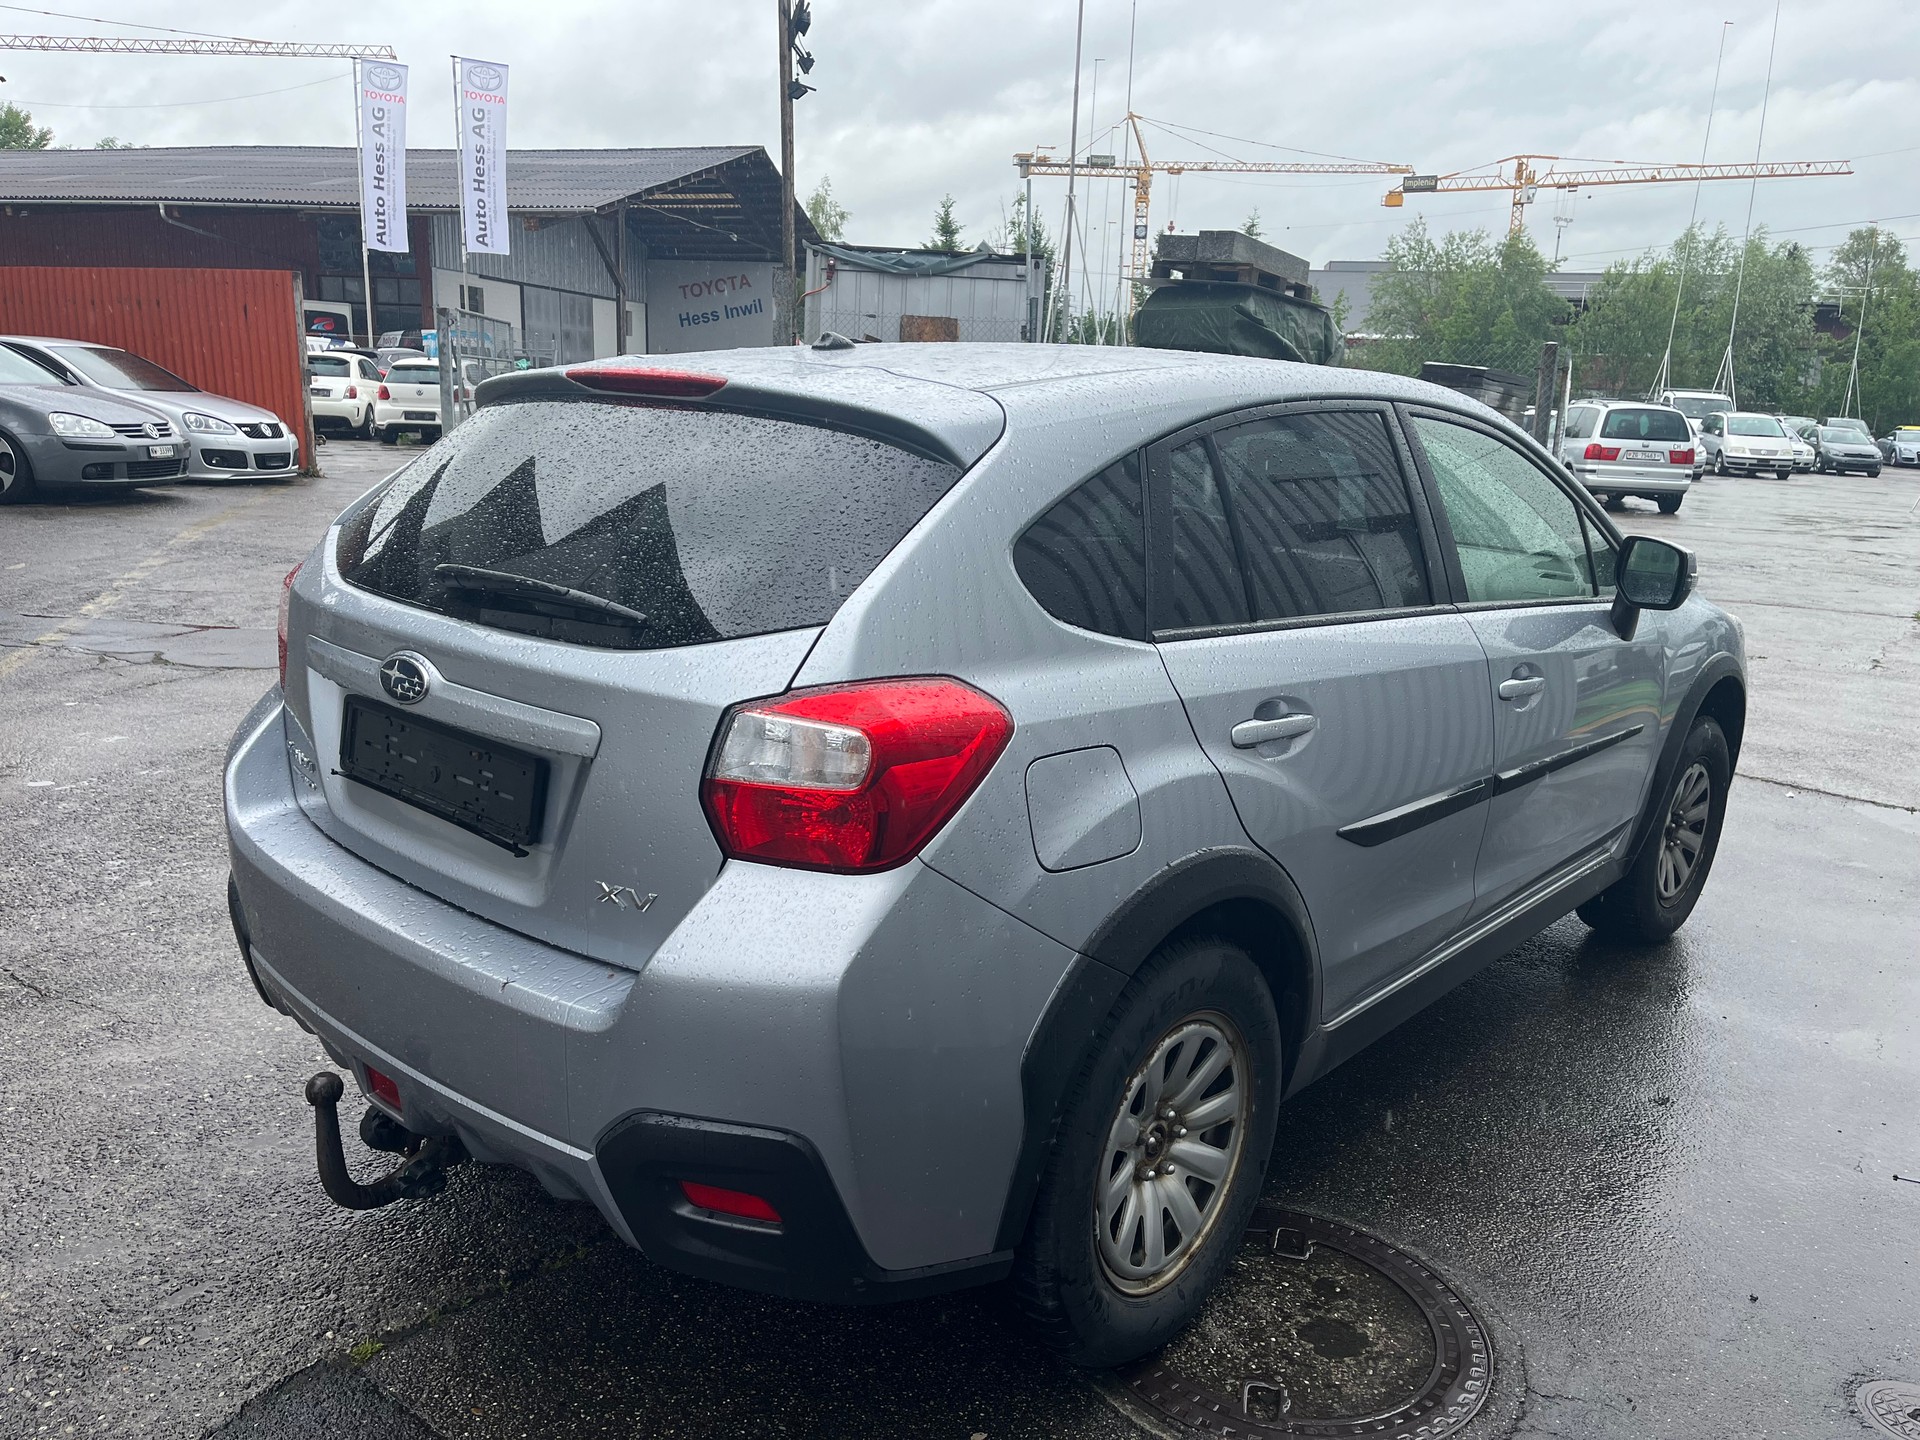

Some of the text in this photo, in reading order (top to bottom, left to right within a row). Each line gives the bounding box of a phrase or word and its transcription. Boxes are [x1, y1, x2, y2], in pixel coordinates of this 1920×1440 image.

[364, 90, 405, 104] TOYOTA
[464, 90, 505, 105] TOYOTA
[372, 107, 387, 246] Auto Hess AG
[472, 107, 488, 247] Auto Hess AG
[1404, 177, 1435, 188] Implenia
[678, 274, 752, 299] TOYOTA
[678, 298, 763, 328] Hess Inwil
[594, 880, 659, 912] XV
